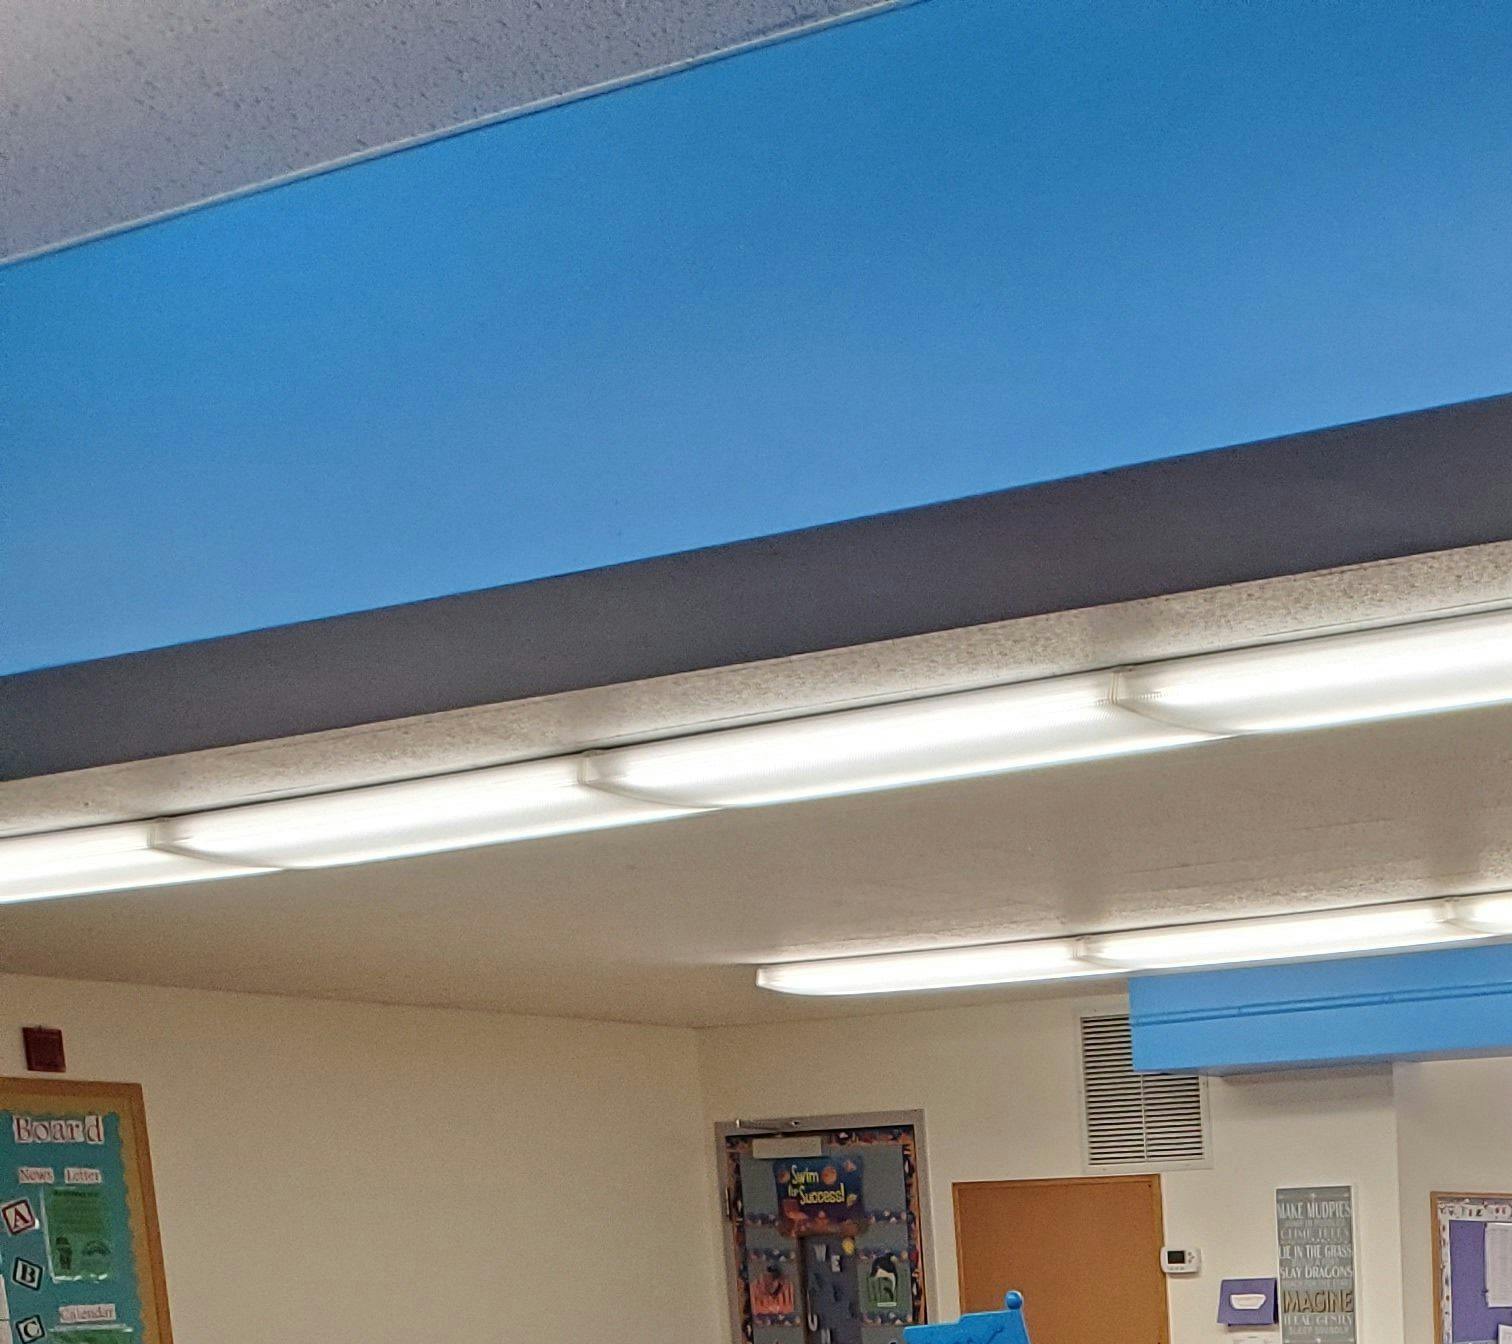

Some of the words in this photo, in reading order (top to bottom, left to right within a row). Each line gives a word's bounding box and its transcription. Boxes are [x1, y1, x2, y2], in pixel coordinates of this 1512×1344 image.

[16, 1115, 103, 1143] Board
[19, 1168, 53, 1183] News
[66, 1168, 99, 1182] Letter
[791, 1165, 819, 1184] Swim
[800, 1183, 845, 1205] Success!
[13, 1208, 30, 1229] A
[1278, 1202, 1304, 1218] MAKE
[1307, 1201, 1351, 1218] MUDPIES
[1306, 1245, 1321, 1259] THE
[1324, 1245, 1352, 1258] GRASS
[21, 1263, 37, 1284] B
[1280, 1266, 1301, 1278] SLAY
[1305, 1265, 1353, 1278] DRAGONS
[1283, 1289, 1354, 1313] IMAGINE
[60, 1306, 114, 1321] Calendar
[23, 1320, 41, 1339] C
